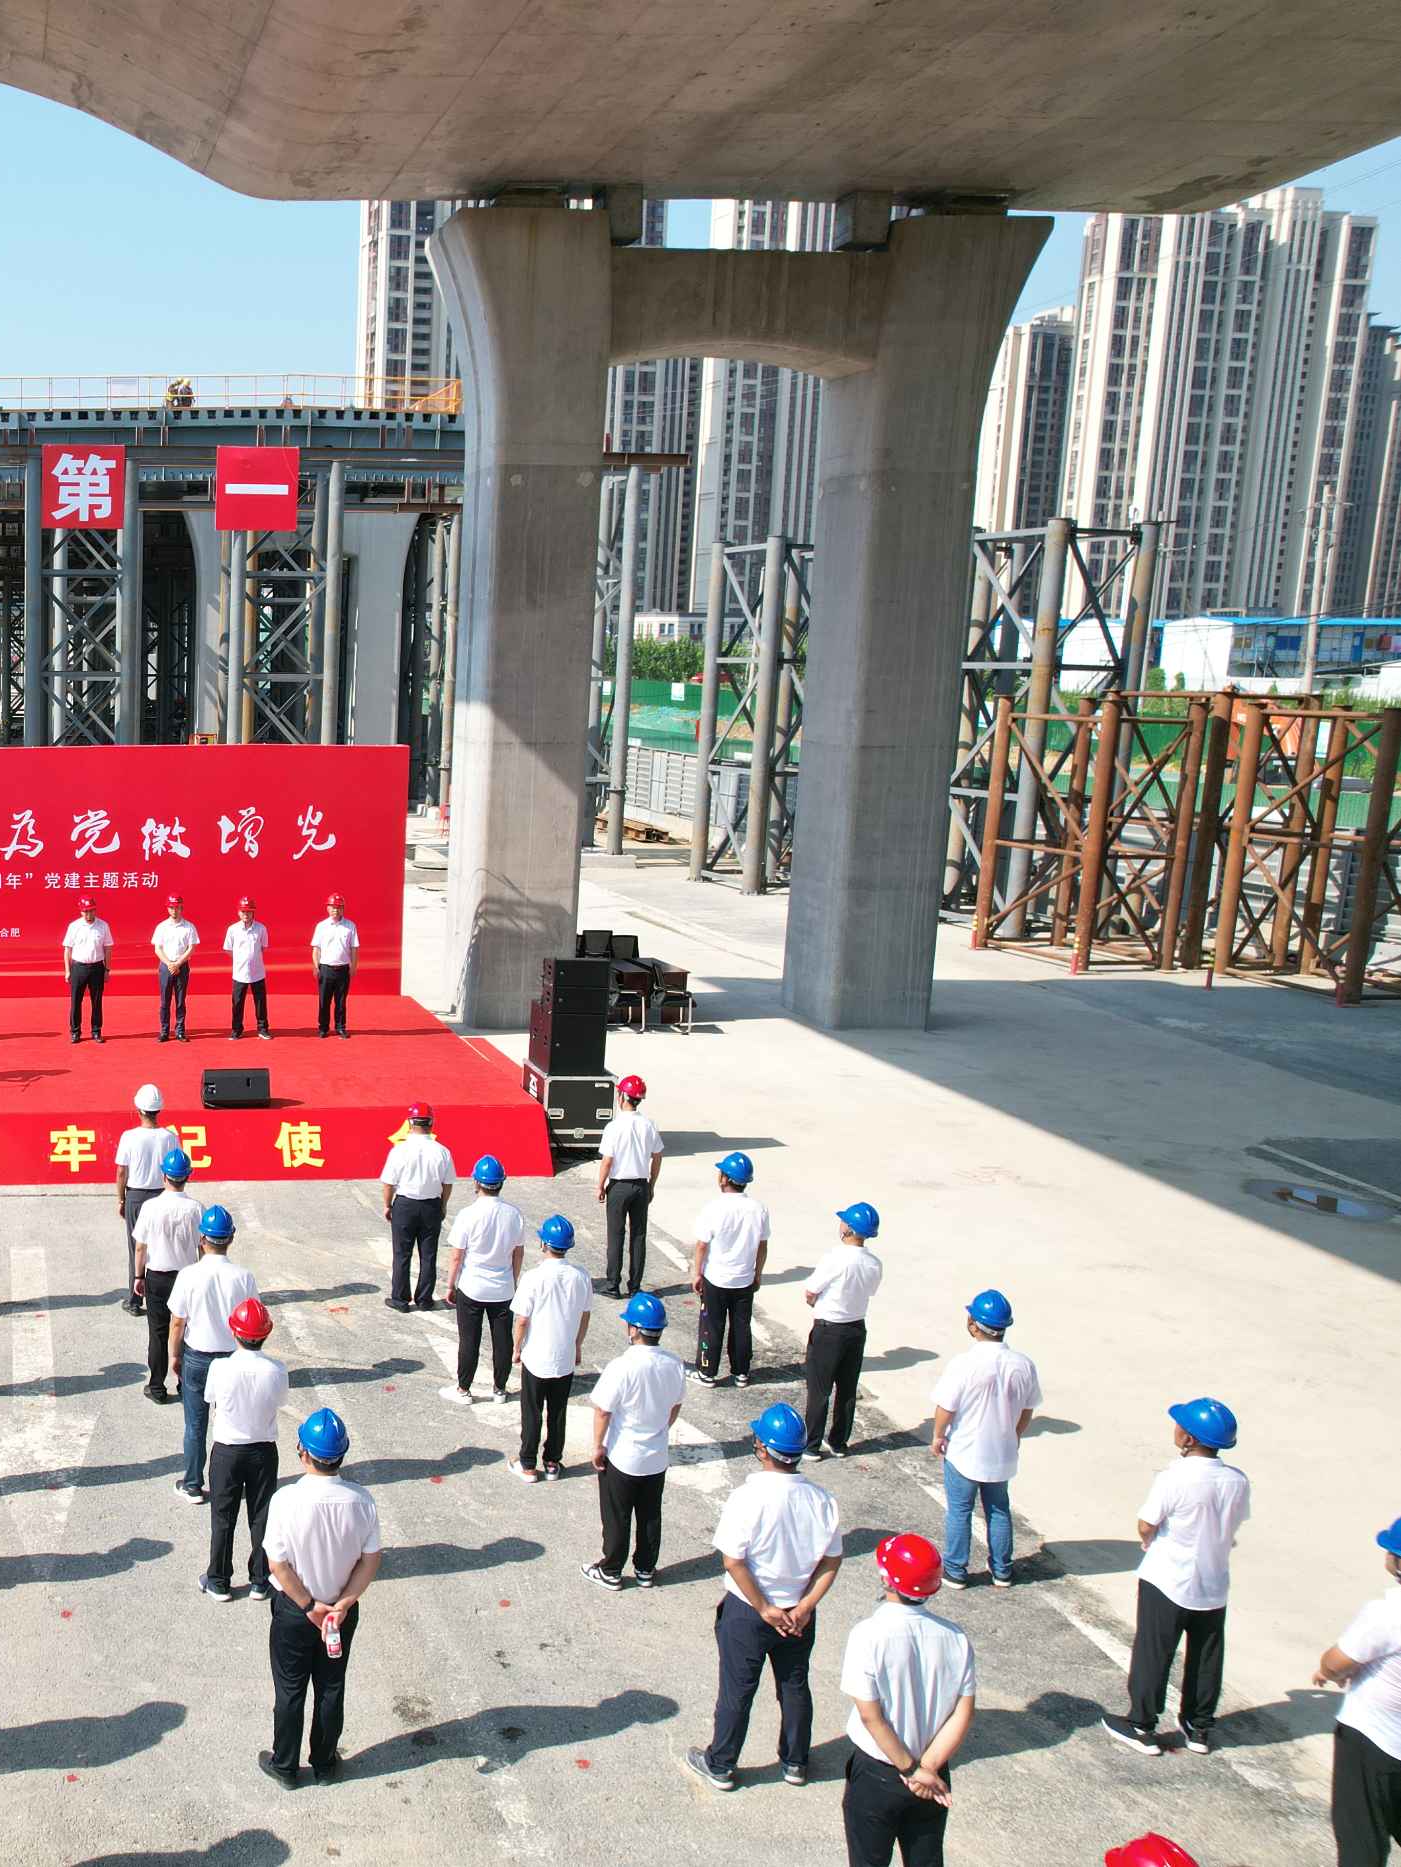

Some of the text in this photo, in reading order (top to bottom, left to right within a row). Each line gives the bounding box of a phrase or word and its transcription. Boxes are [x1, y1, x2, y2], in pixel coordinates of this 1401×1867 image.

[44, 871, 159, 889] 党建主题活动
[50, 1119, 437, 1173] 牢记使
